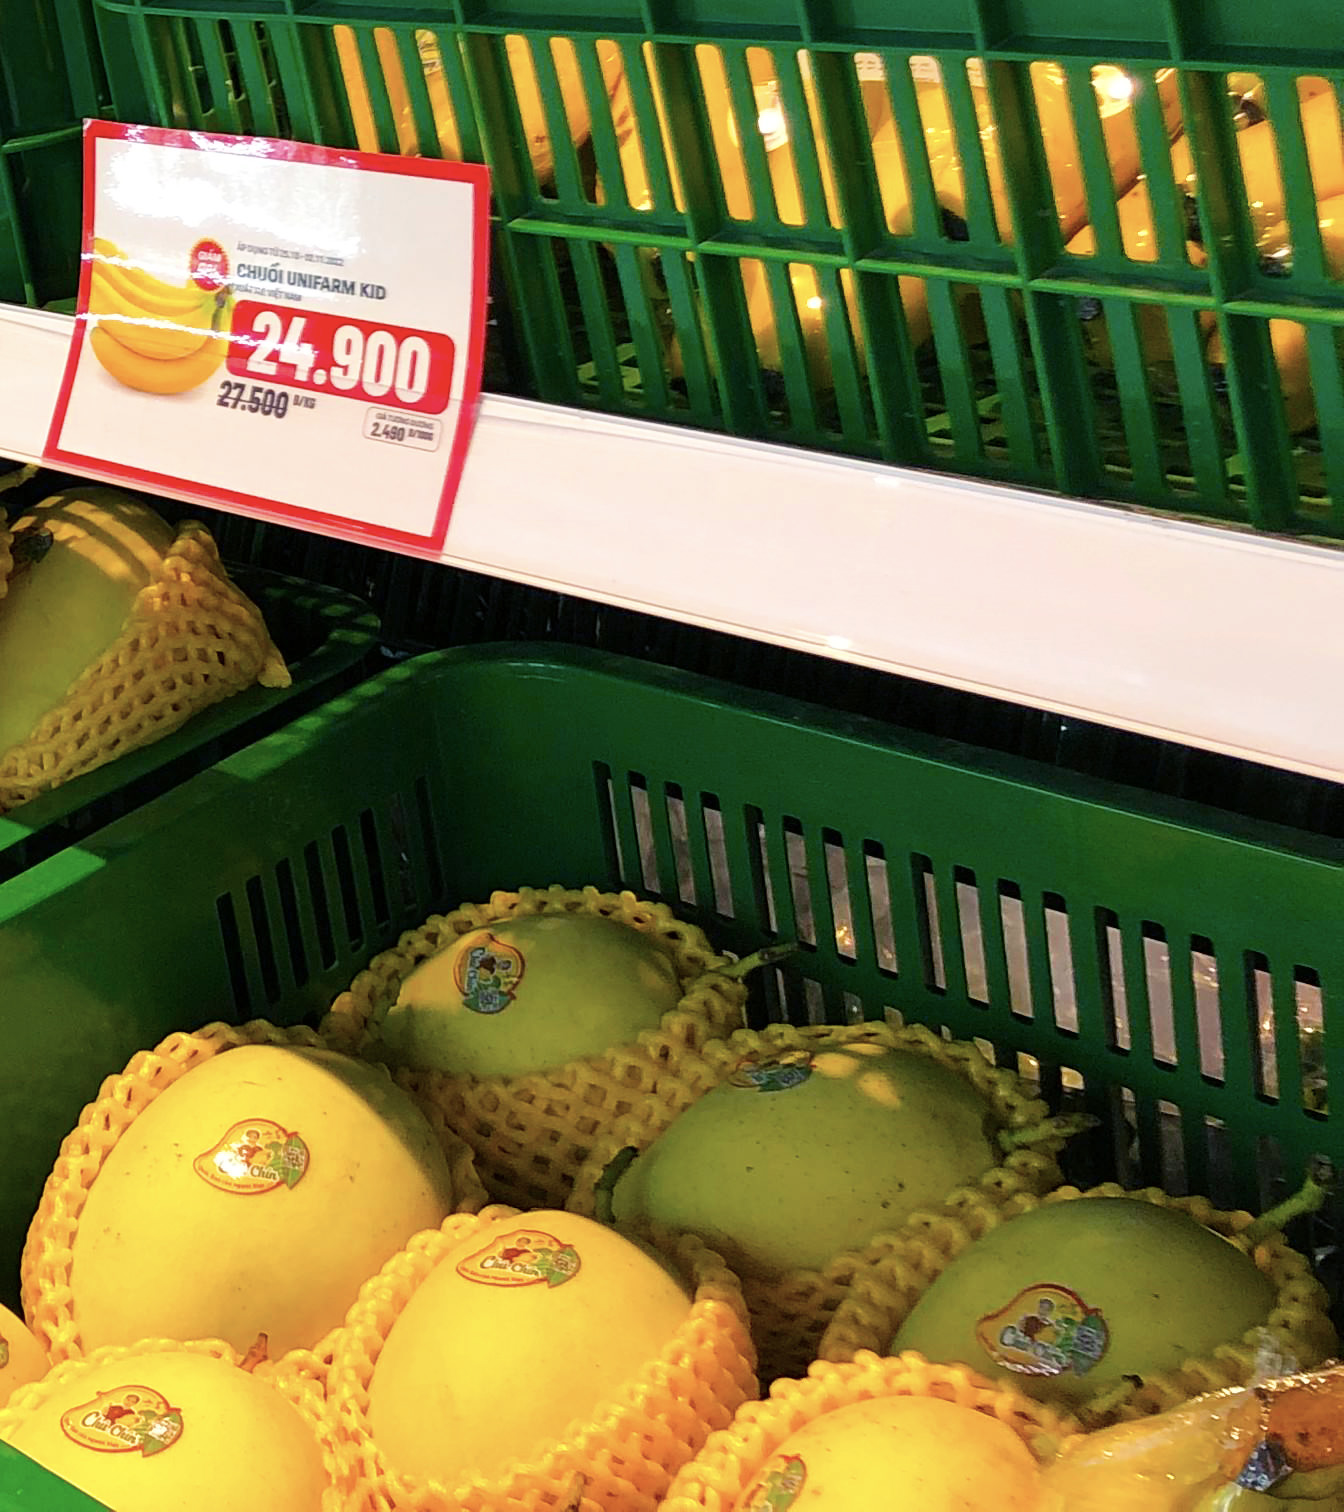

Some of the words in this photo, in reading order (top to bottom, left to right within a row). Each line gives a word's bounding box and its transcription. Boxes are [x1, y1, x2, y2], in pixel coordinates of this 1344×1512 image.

[236, 262, 284, 284] CHUỐI
[287, 270, 356, 296] UNIFARM
[359, 283, 387, 300] KID
[246, 310, 431, 404] 24.900
[216, 380, 289, 419] 27.500
[370, 422, 406, 442] 2.490
